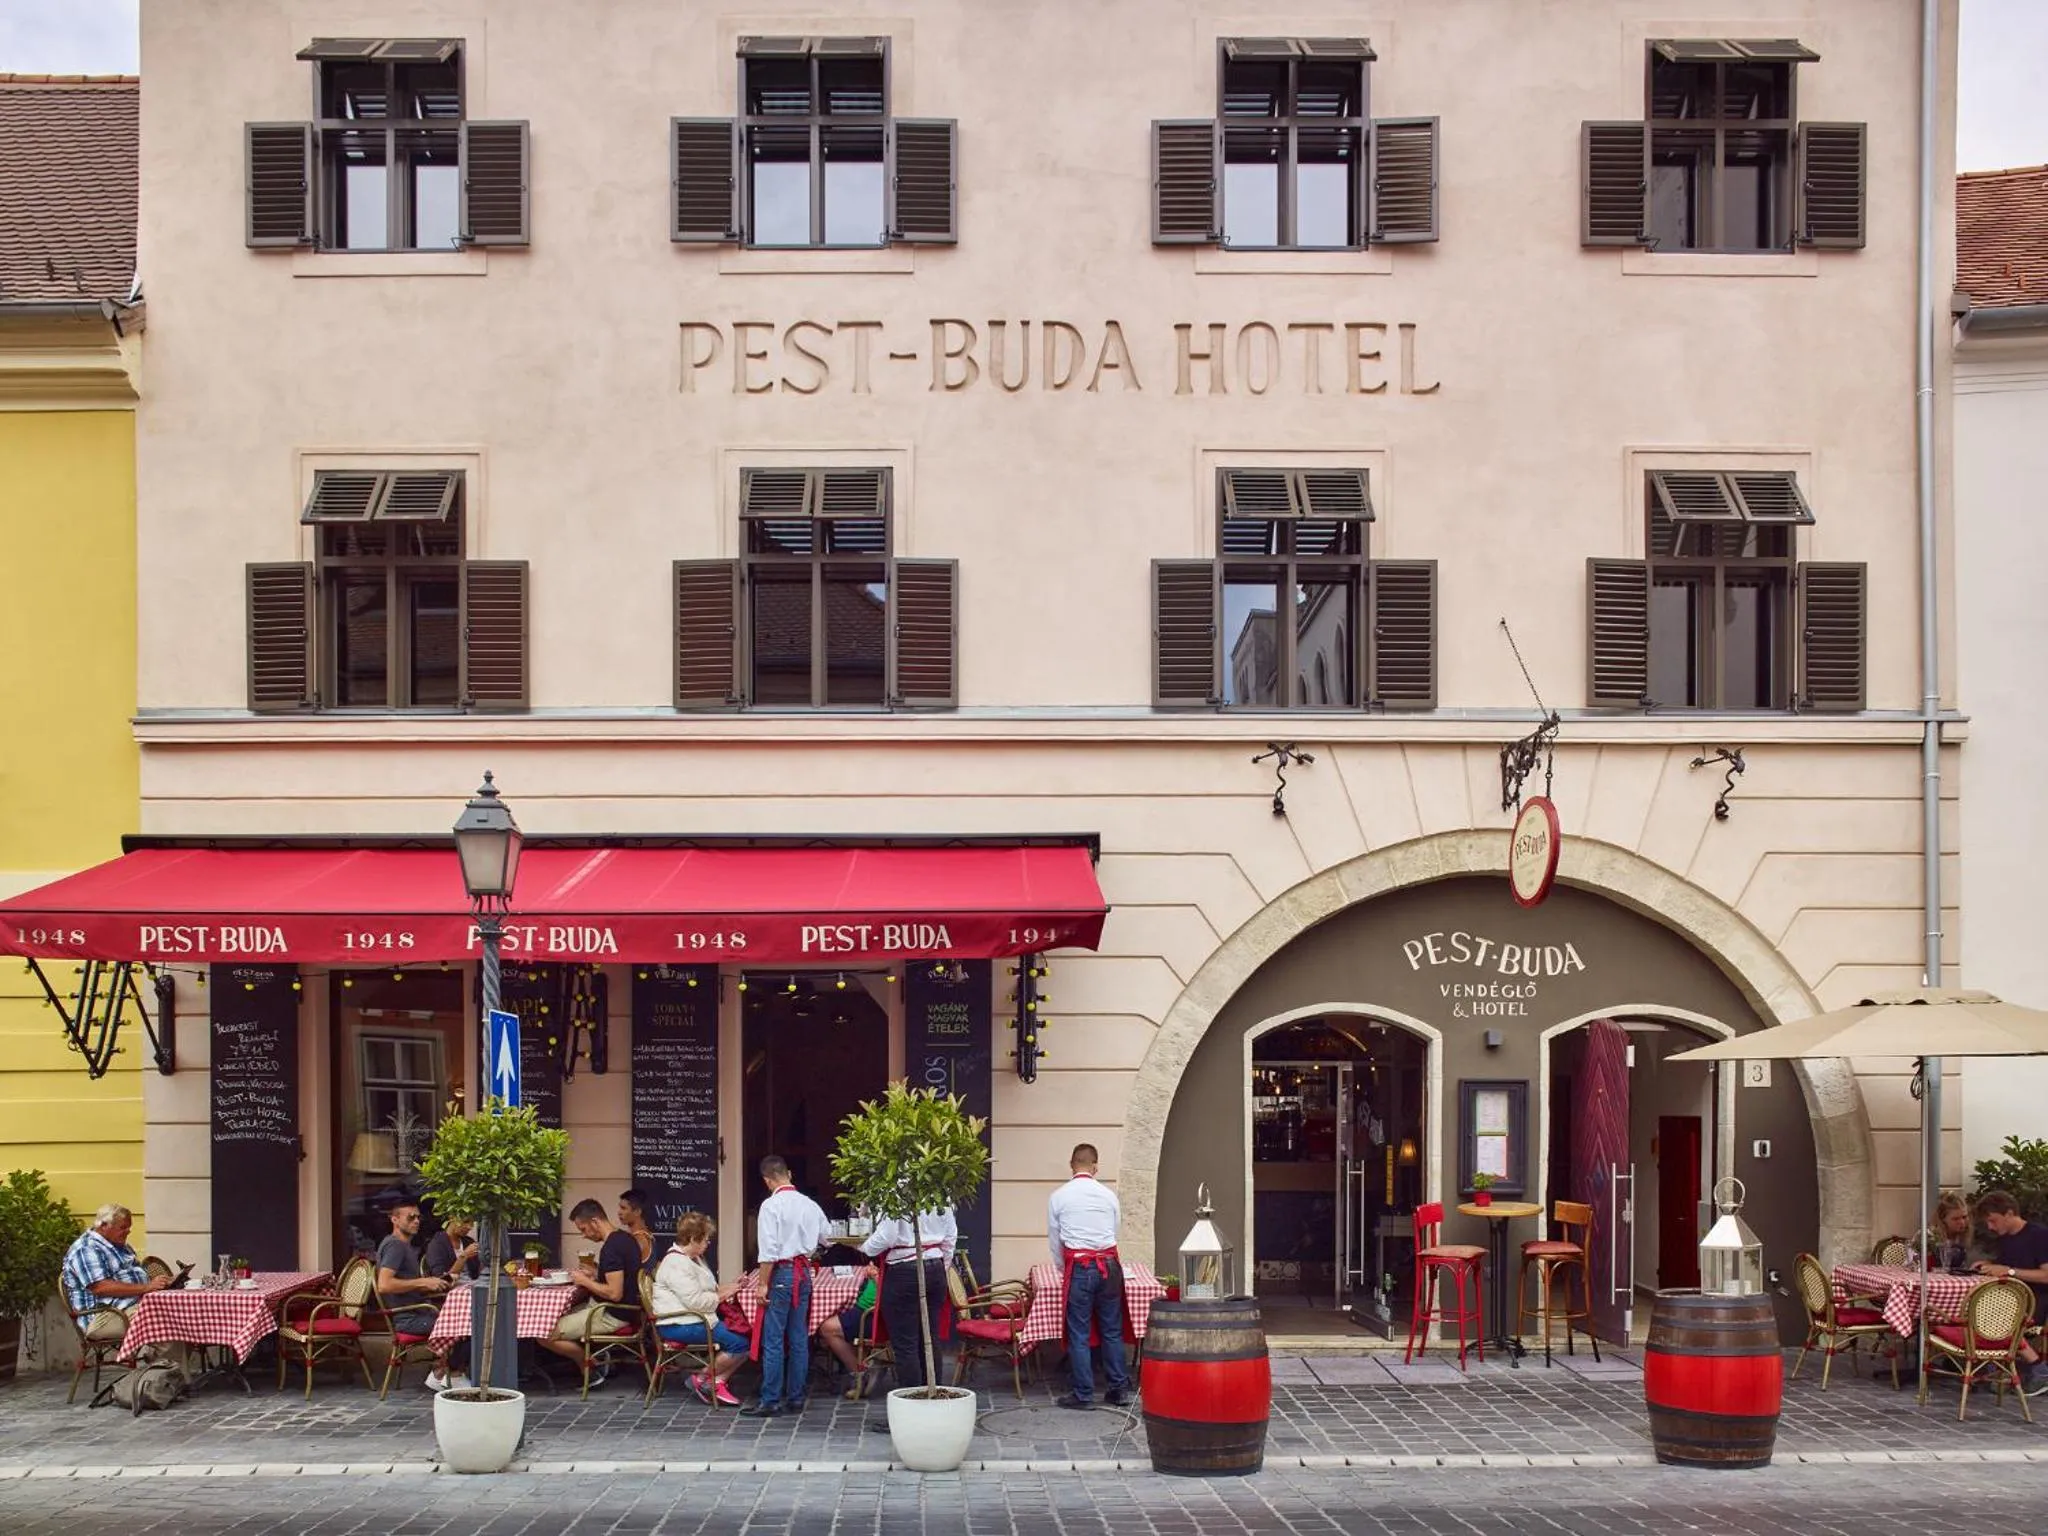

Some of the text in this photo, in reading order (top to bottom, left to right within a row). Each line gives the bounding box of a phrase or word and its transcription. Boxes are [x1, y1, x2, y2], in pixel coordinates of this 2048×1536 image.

[679, 319, 1441, 395] PEST-BUDA HOTEL
[15, 928, 87, 946] 1948
[343, 932, 416, 949] 1948
[466, 925, 619, 954] PST·BUDA
[673, 932, 747, 949] 1948
[1007, 927, 1076, 945] 194
[1453, 1002, 1529, 1018] & HOTEL
[1752, 1065, 1763, 1082] 3
